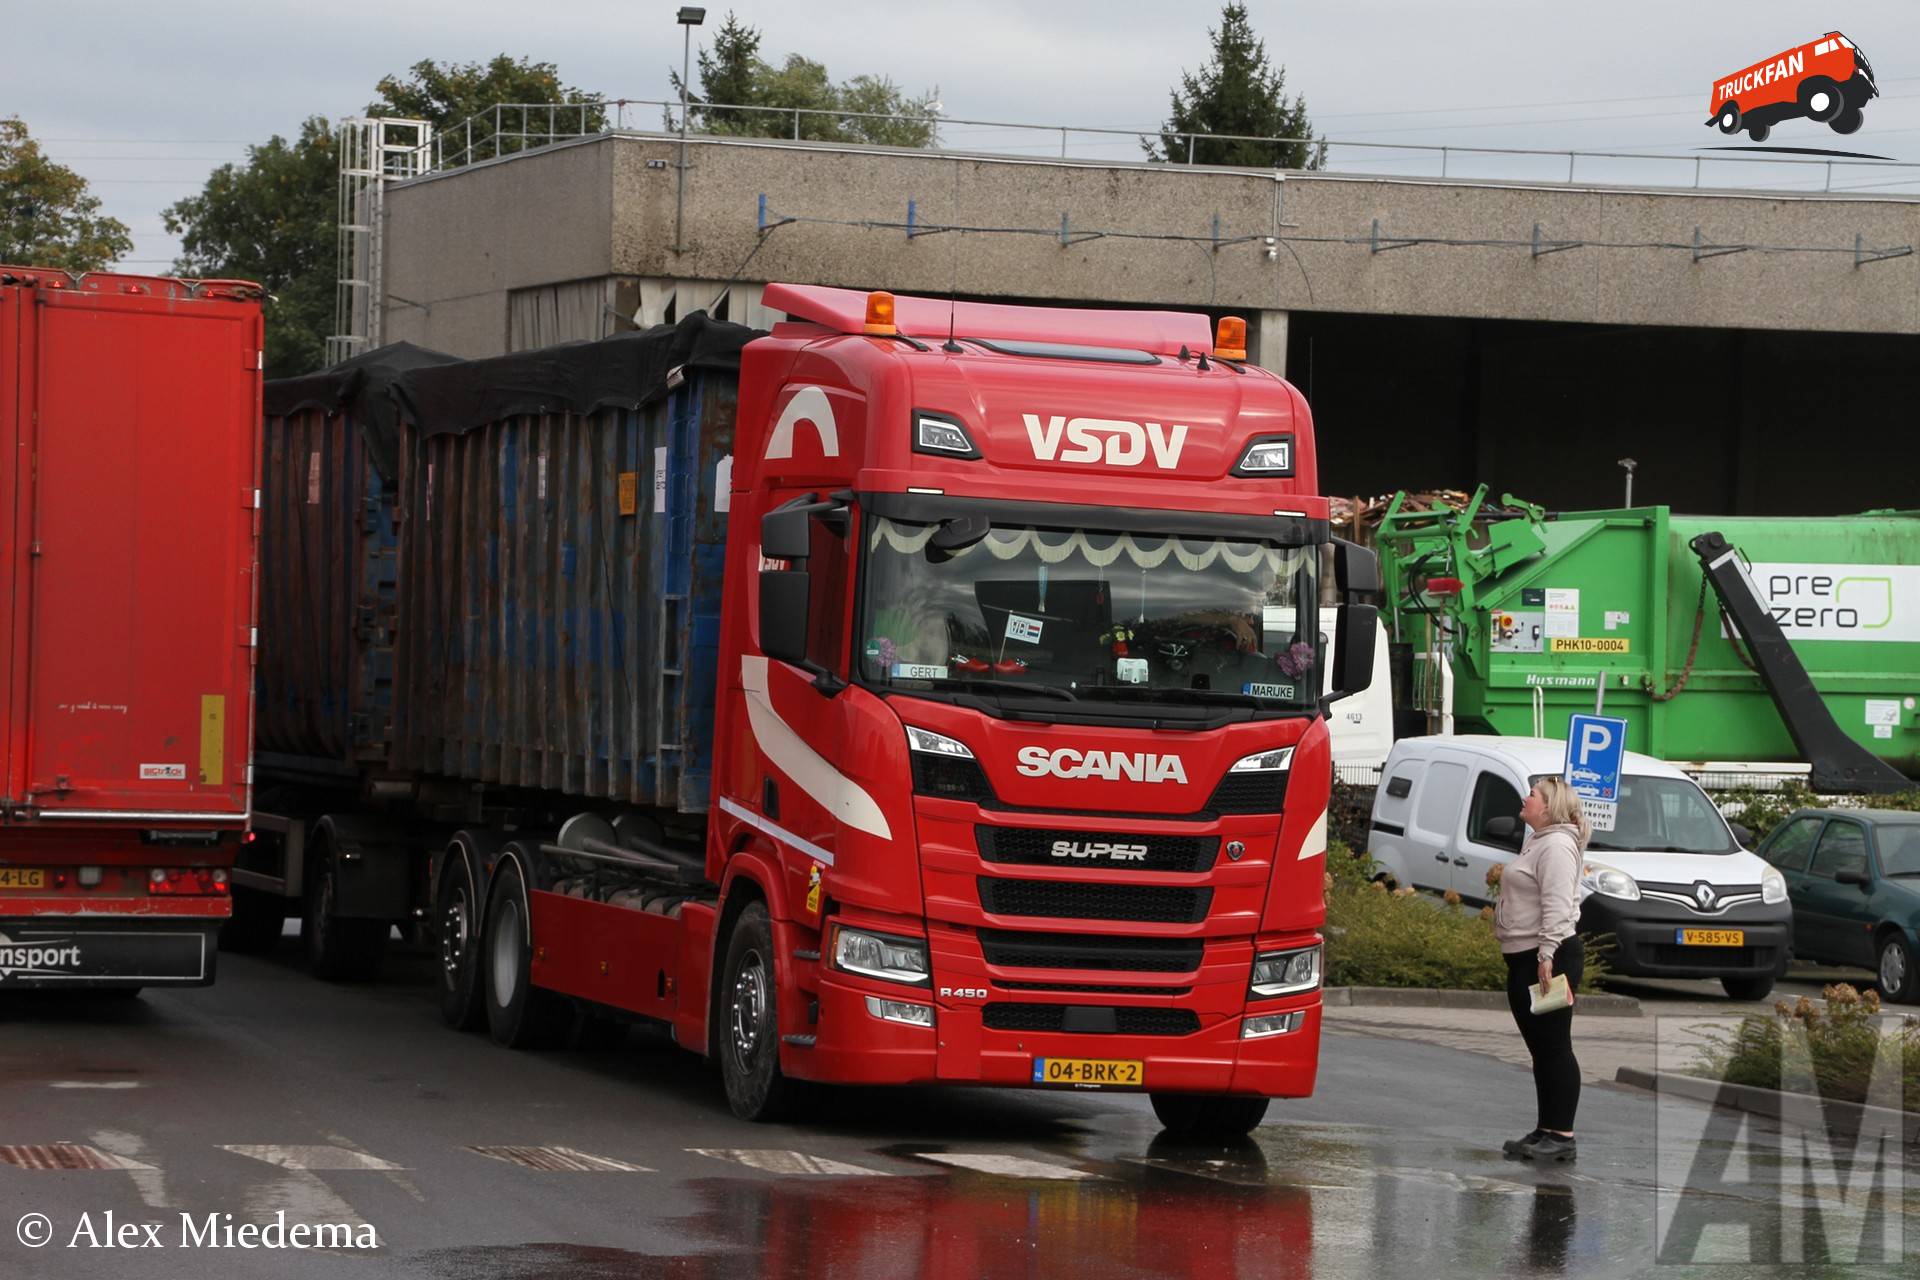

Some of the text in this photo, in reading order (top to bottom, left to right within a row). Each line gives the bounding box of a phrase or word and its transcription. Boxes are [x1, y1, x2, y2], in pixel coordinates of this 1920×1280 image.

[1022, 413, 1189, 470] VSDV
[1770, 575, 1832, 602] pre
[1771, 607, 1857, 628] zero
[1556, 639, 1624, 651] PHK10-0004
[910, 666, 938, 679] GERT
[1526, 674, 1596, 686] Husmann
[1580, 723, 1611, 765] P
[1016, 746, 1188, 784] SCANIA
[1581, 801, 1610, 810] teruit
[1583, 811, 1612, 820] rkeren
[1051, 841, 1148, 861] SUPER
[1686, 931, 1740, 944] V-585-VS
[1049, 1061, 1137, 1081] 04-BRK-2
